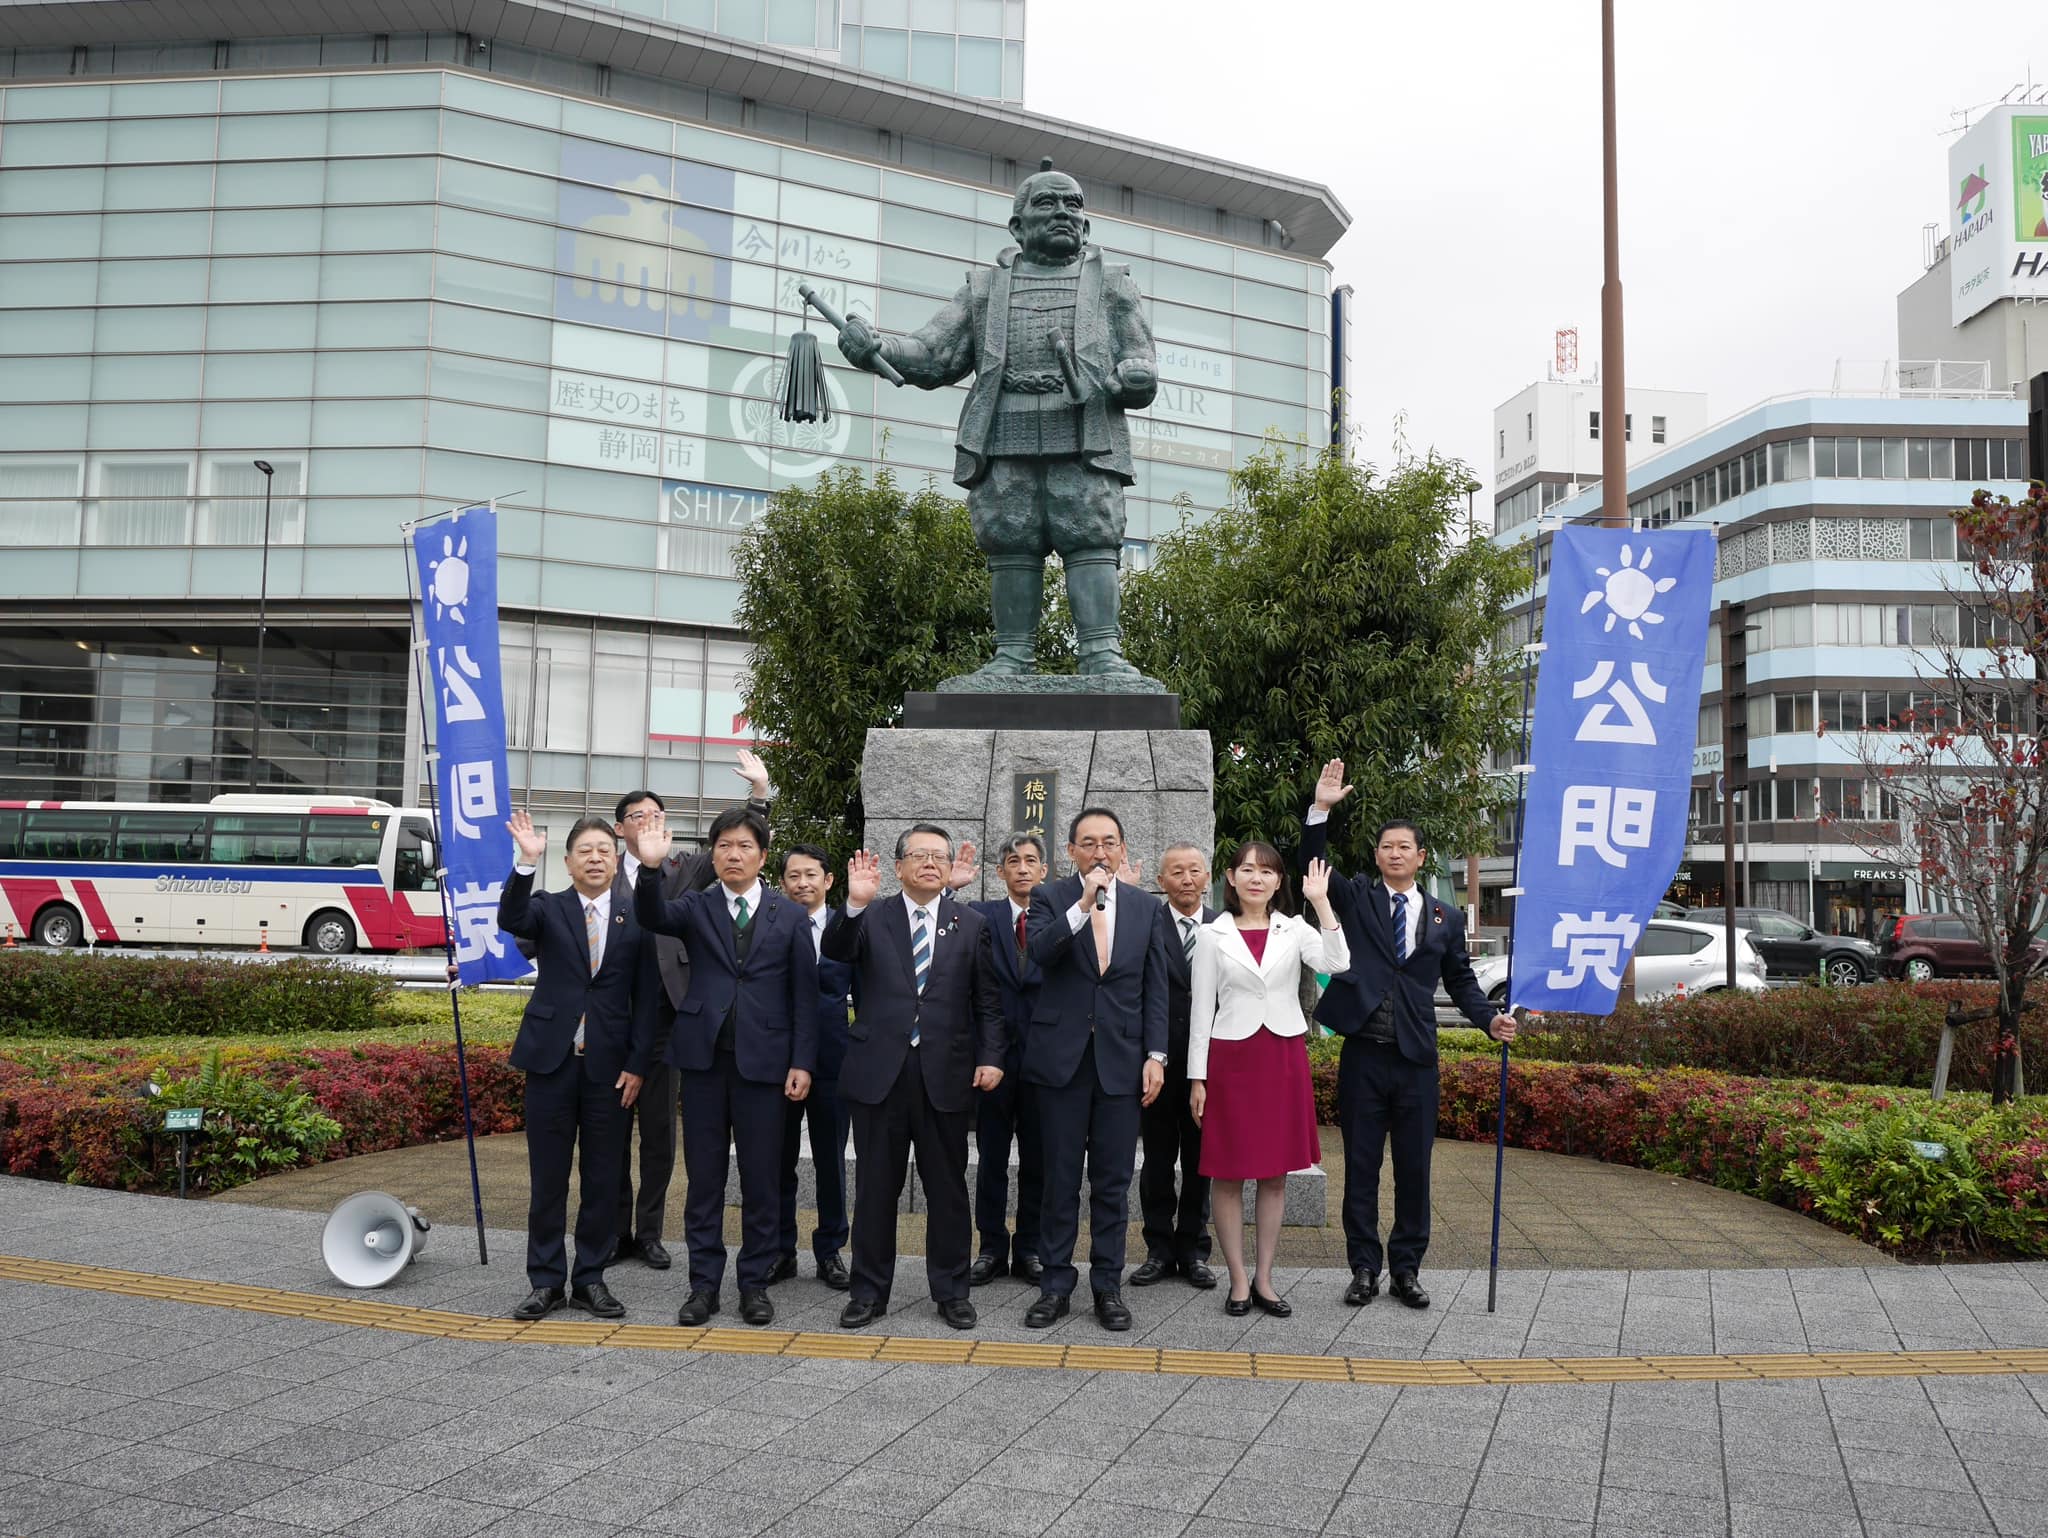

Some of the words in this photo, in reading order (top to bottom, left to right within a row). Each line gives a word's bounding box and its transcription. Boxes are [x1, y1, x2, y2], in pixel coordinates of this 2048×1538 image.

[737, 224, 851, 269] 今川から
[1953, 208, 1993, 251] HARADA
[554, 379, 686, 424] 歴史のまち
[597, 428, 695, 469] 静岡市
[1702, 750, 1722, 766] BLD
[1546, 660, 1668, 991] 公明党
[155, 874, 253, 894] Shizutetsu
[1853, 869, 1896, 880] FREAK'S
